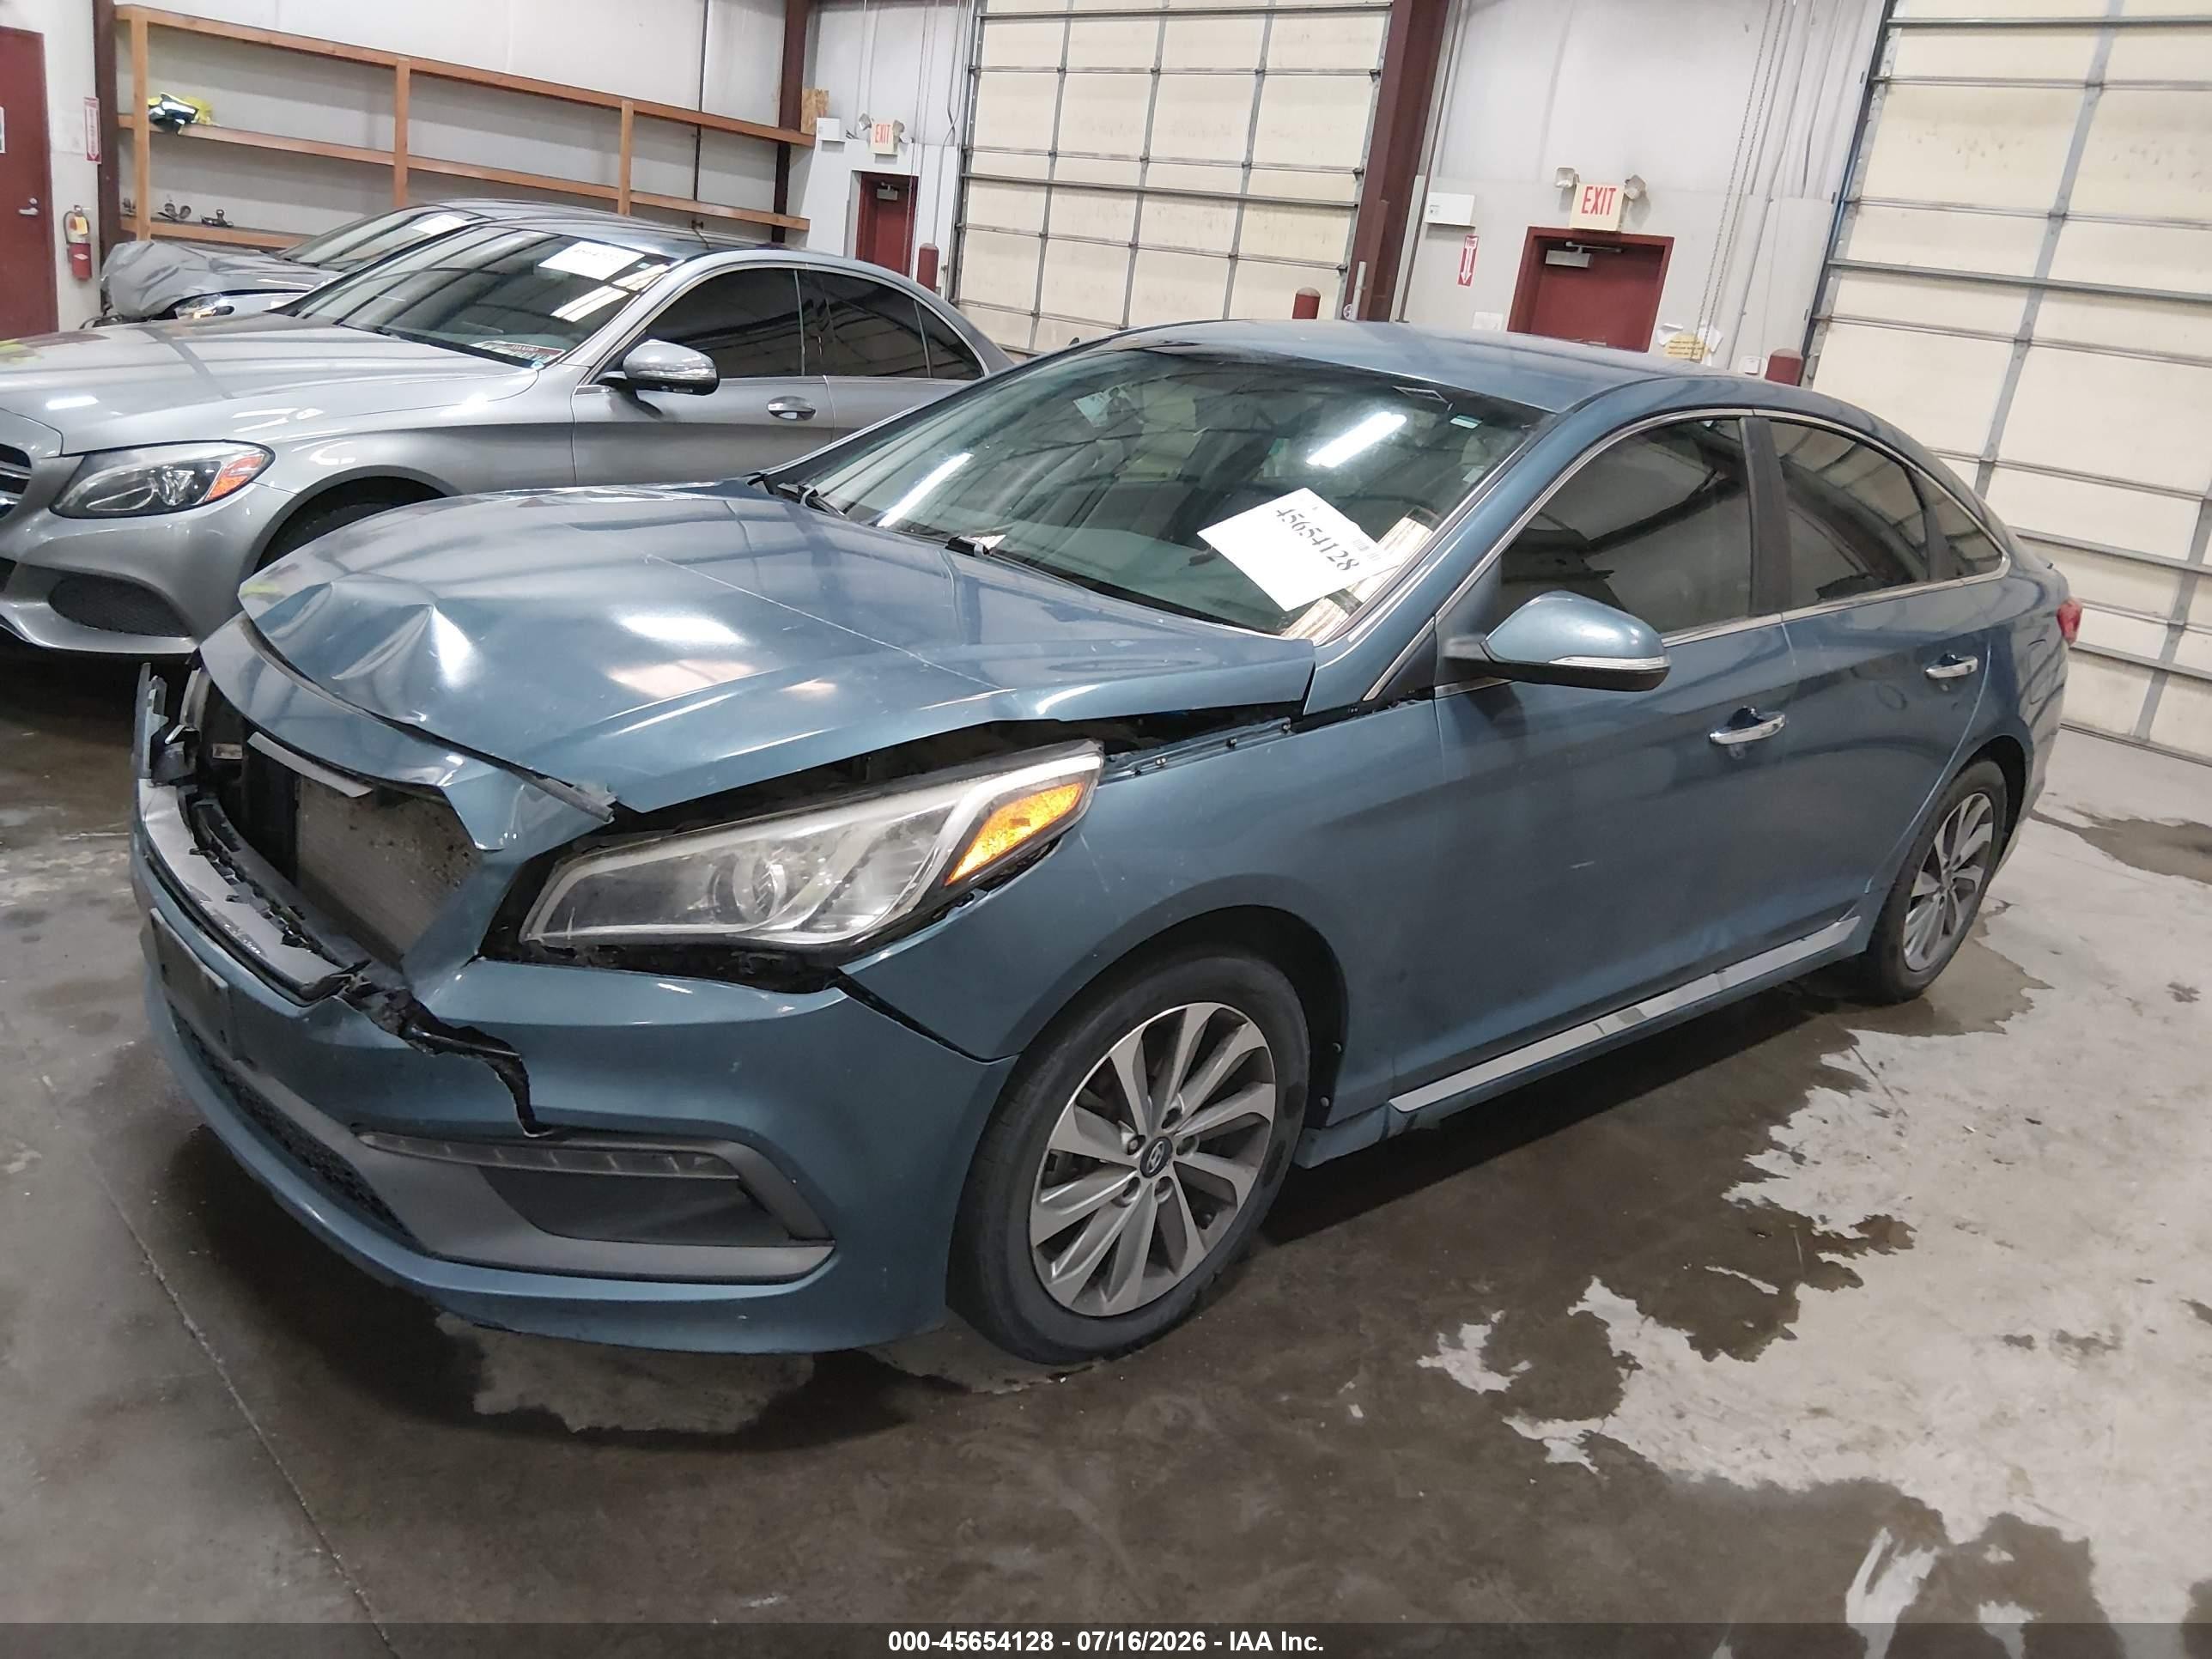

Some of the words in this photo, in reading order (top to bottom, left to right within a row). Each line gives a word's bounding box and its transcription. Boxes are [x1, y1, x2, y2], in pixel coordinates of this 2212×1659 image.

[874, 124, 890, 144] EXIT
[1581, 185, 1617, 216] EXIT
[1276, 508, 1360, 571] 45654128
